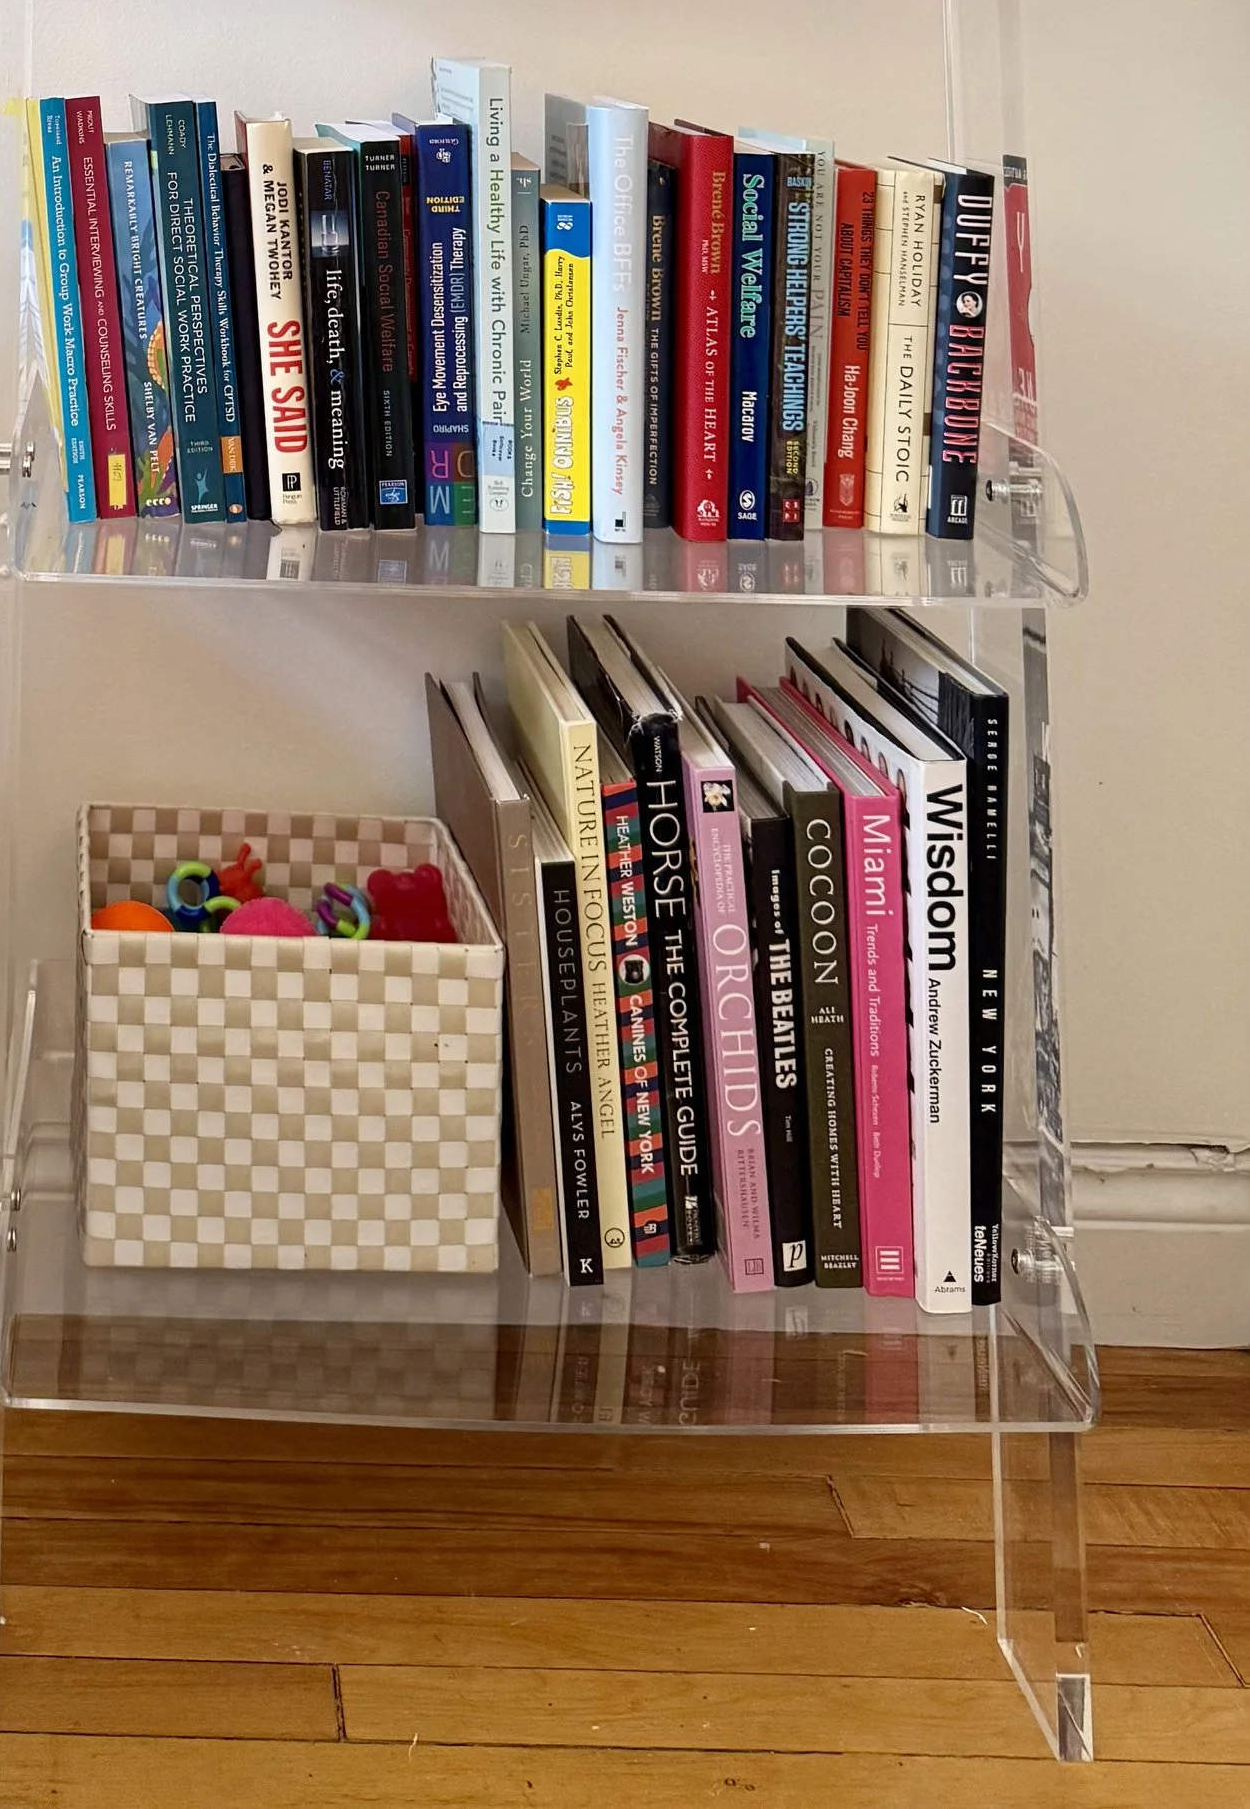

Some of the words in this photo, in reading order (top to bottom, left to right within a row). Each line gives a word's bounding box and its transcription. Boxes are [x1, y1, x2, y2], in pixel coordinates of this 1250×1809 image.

[487, 98, 503, 146] Living
[52, 156, 62, 172] An
[490, 154, 500, 162] a
[83, 157, 96, 215] ESSENTIAL
[277, 182, 289, 213] JODI
[487, 170, 504, 233] Healthy
[711, 171, 726, 219] Brené
[52, 175, 67, 247] Introduction
[786, 202, 809, 265] STRONG
[58, 249, 67, 260] to
[88, 218, 104, 298] INTERVIEWING
[281, 219, 293, 280] KANTOR
[490, 241, 506, 270] Life
[710, 221, 724, 273] Brown
[953, 195, 992, 284] DUFFY
[57, 263, 70, 300] Group
[323, 270, 343, 304] life,
[431, 243, 445, 327] Desensitization
[491, 277, 507, 312] with
[785, 269, 808, 339] HELPERS'
[63, 304, 73, 335] Work
[326, 307, 344, 363] death,
[616, 307, 628, 342] Jenna
[650, 329, 659, 348] THE
[65, 337, 75, 376] Macro
[97, 318, 113, 392] COUNSELING
[267, 320, 303, 376] SHE
[432, 330, 445, 388] Movement
[453, 317, 468, 388] Reprocessing
[491, 320, 505, 383] Chronic
[616, 347, 627, 390] Fischer
[650, 352, 658, 382] GIFTS
[903, 337, 912, 359] THE
[330, 369, 345, 384] &
[519, 360, 532, 401] World
[616, 395, 627, 404] &
[650, 386, 658, 400] OF
[782, 344, 805, 430] TEACHINGS
[843, 365, 860, 414] Ha-Joon
[898, 366, 913, 419] DAILY
[942, 325, 985, 463] BACKBONE
[66, 379, 80, 426] Practice
[103, 396, 116, 430] SKILLS
[144, 382, 156, 420] SHELBY
[271, 386, 307, 453] SAID
[383, 390, 391, 417] SIXTH
[432, 392, 447, 412] Eye
[456, 392, 467, 412] and
[523, 408, 532, 438] Your
[741, 392, 757, 441] Macarov
[147, 424, 157, 445] VAN
[329, 390, 346, 468] meaning
[384, 421, 393, 456] EDITION
[612, 408, 627, 450] Angela
[649, 404, 658, 484] IMPERFECTION
[838, 418, 857, 458] Chang
[150, 451, 159, 472] PELT
[521, 446, 533, 497] Change
[612, 455, 627, 494] Kinsey
[896, 426, 911, 482] STOIC
[573, 745, 598, 847] NATURE
[582, 854, 600, 881] IN
[646, 780, 685, 917] HORSE
[863, 816, 893, 915] Miami
[926, 784, 964, 970] Wisdom
[806, 819, 838, 984] COCOON
[584, 890, 606, 971] FOCUS
[664, 930, 683, 974] THE
[867, 924, 879, 964] Trends
[553, 890, 581, 1073] HOUSEPLANTS
[769, 939, 792, 984] THE
[868, 969, 880, 991] and
[928, 978, 941, 1035] Andrew
[981, 970, 997, 1020] NEW
[629, 994, 647, 1062] CANINES
[668, 982, 692, 1101] COMPLETE
[713, 924, 759, 1136] ORCHIDS
[771, 990, 797, 1088] BEATLES
[868, 997, 882, 1056] Traditions
[634, 1066, 649, 1087] OF
[824, 1048, 836, 1107] CREATING
[929, 1040, 942, 1123] Zuckerman
[981, 1046, 996, 1112] YORK
[571, 1102, 586, 1142] ALYS
[636, 1092, 651, 1128] NEW
[827, 1110, 838, 1150] HOMES
[637, 1131, 654, 1173] YORK
[677, 1107, 697, 1175] GUIDE
[573, 1150, 589, 1218] FOWLER
[829, 1154, 840, 1185] WITH
[830, 1190, 842, 1228] HEART
[973, 1225, 987, 1282] teNeues
